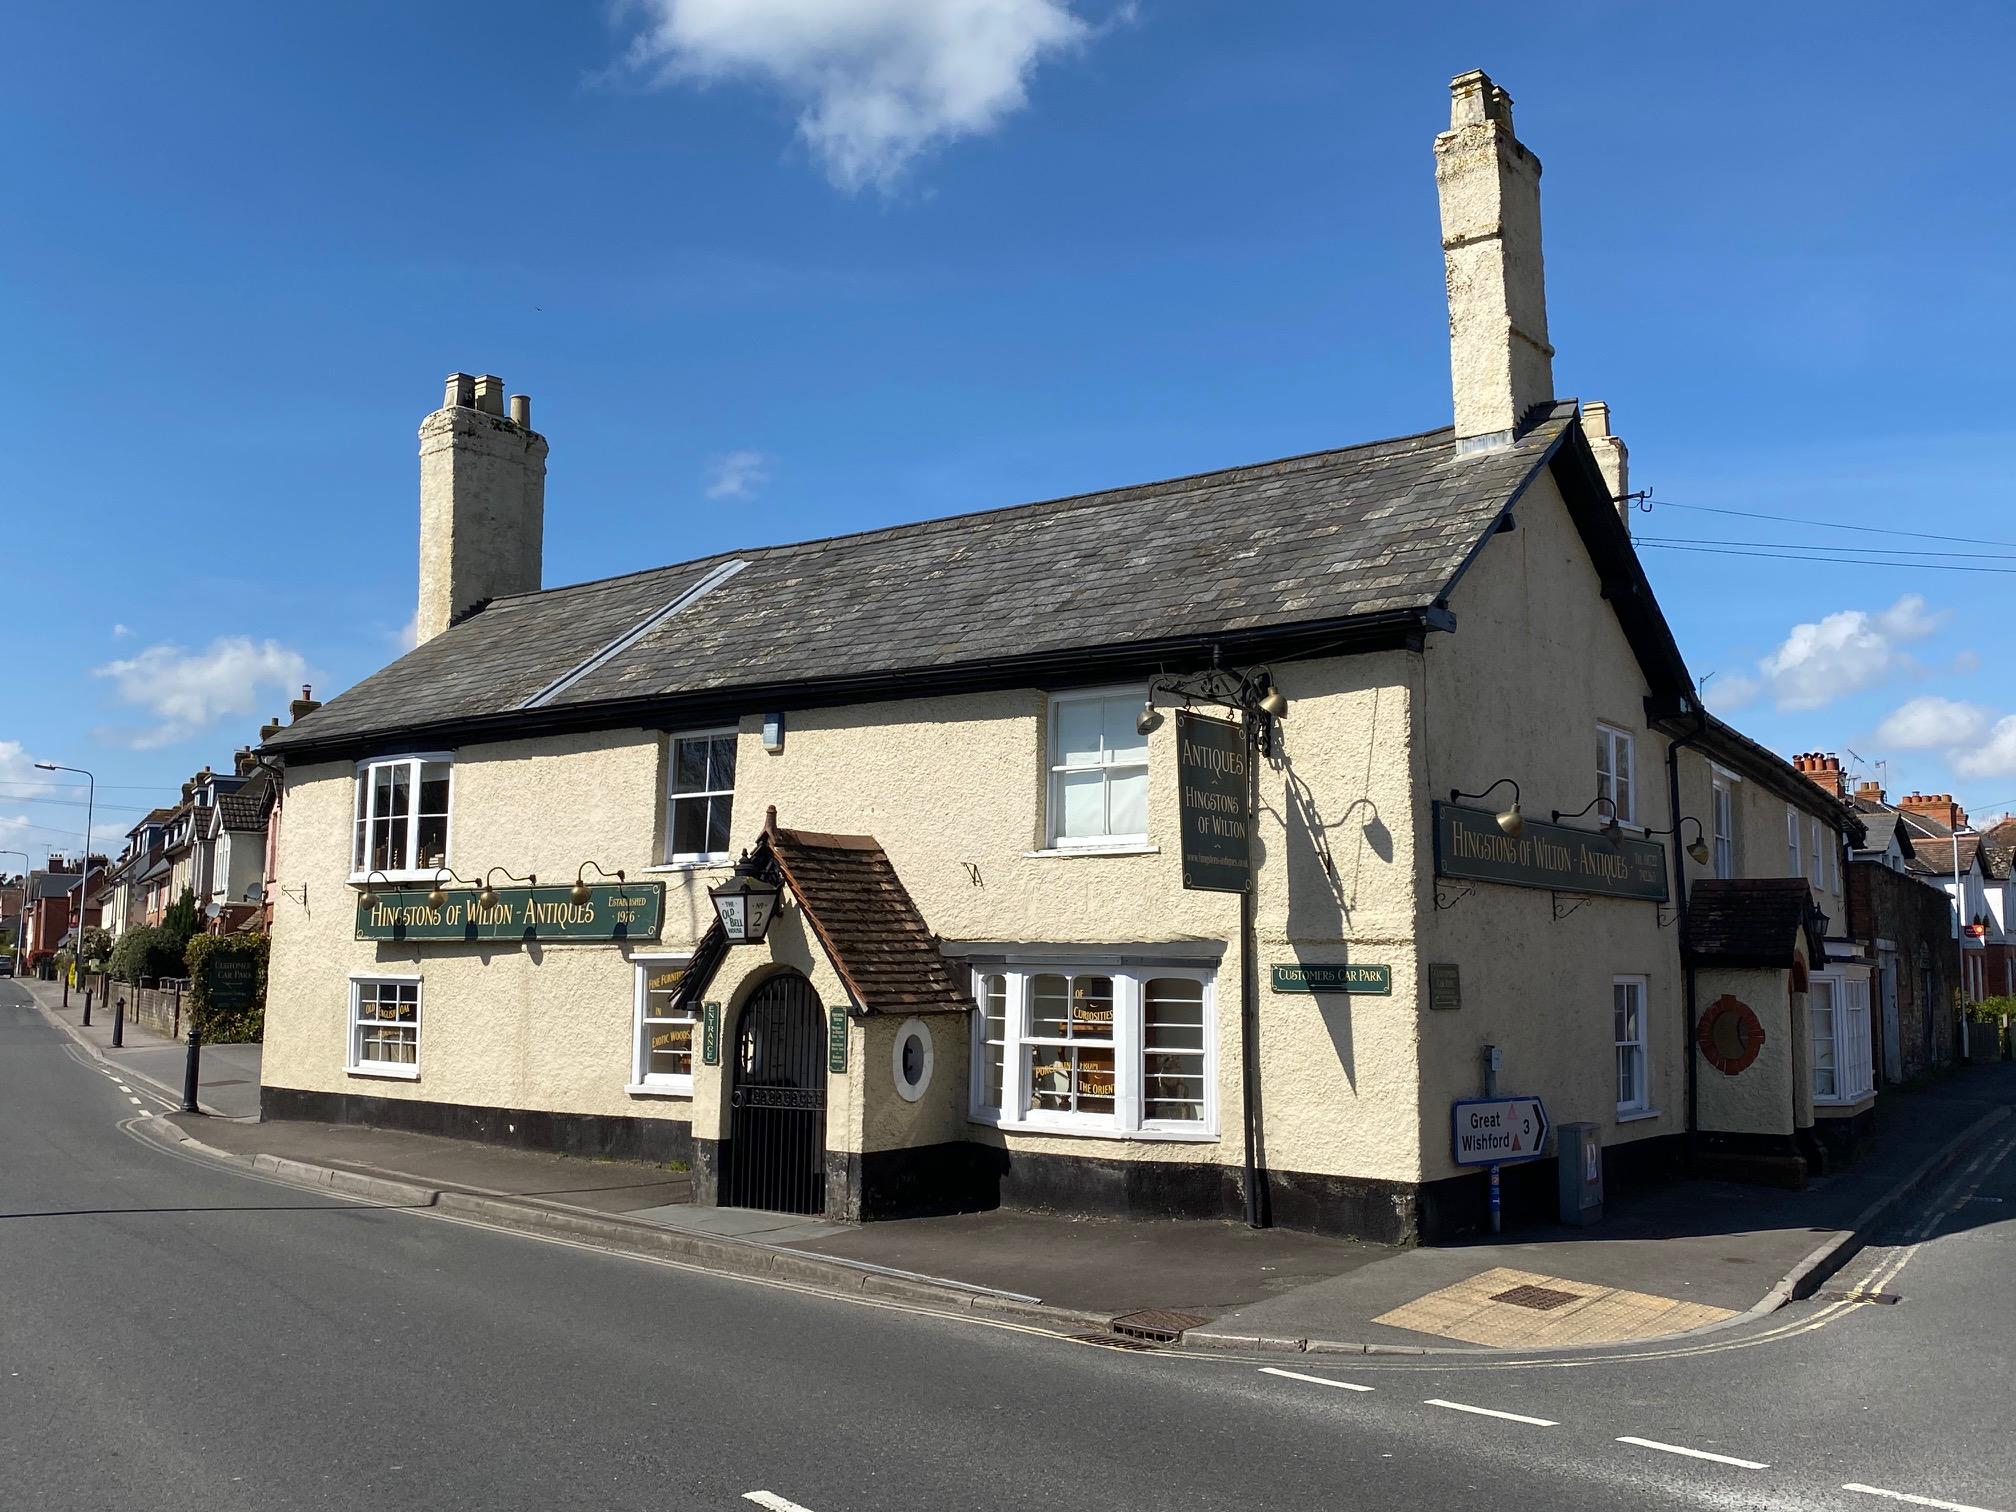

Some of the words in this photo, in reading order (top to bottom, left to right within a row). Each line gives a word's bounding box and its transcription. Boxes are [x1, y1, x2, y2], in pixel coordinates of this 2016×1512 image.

[1182, 739, 1244, 779] ANTIQUES
[1185, 786, 1239, 815] HINGSTONS
[1198, 816, 1210, 834] OF
[1212, 814, 1246, 839] WILTON
[1452, 820, 1517, 865] HINGSTONS
[1519, 839, 1532, 867] OF
[1533, 835, 1571, 873] WILTON
[1579, 843, 1628, 885] ANTIQUES
[608, 896, 647, 908] ESTABISHED
[370, 901, 441, 927] HINGSTONS
[446, 905, 462, 926] OF
[466, 899, 514, 926] WILTON
[523, 898, 595, 930] ANTIQUES
[617, 910, 636, 923] 1976
[722, 908, 735, 919] OLD
[752, 911, 763, 927] 2
[730, 918, 744, 927] BELL
[1278, 966, 1335, 982] CUSTOMERS
[1337, 967, 1357, 982] CAR
[1358, 968, 1383, 982] PARK
[649, 977, 660, 989] FINE
[1075, 989, 1084, 999] OF
[365, 1003, 376, 1015] OLD
[655, 1006, 662, 1016] IN
[1073, 1006, 1113, 1021] CURIOSITIES
[706, 1005, 715, 1060] ENTRANCE
[652, 1033, 669, 1048] EXOTIC
[1079, 1080, 1092, 1094] THE
[1470, 1112, 1501, 1129] Great
[1523, 1119, 1530, 1135] 3
[1462, 1132, 1510, 1151] Wishford
